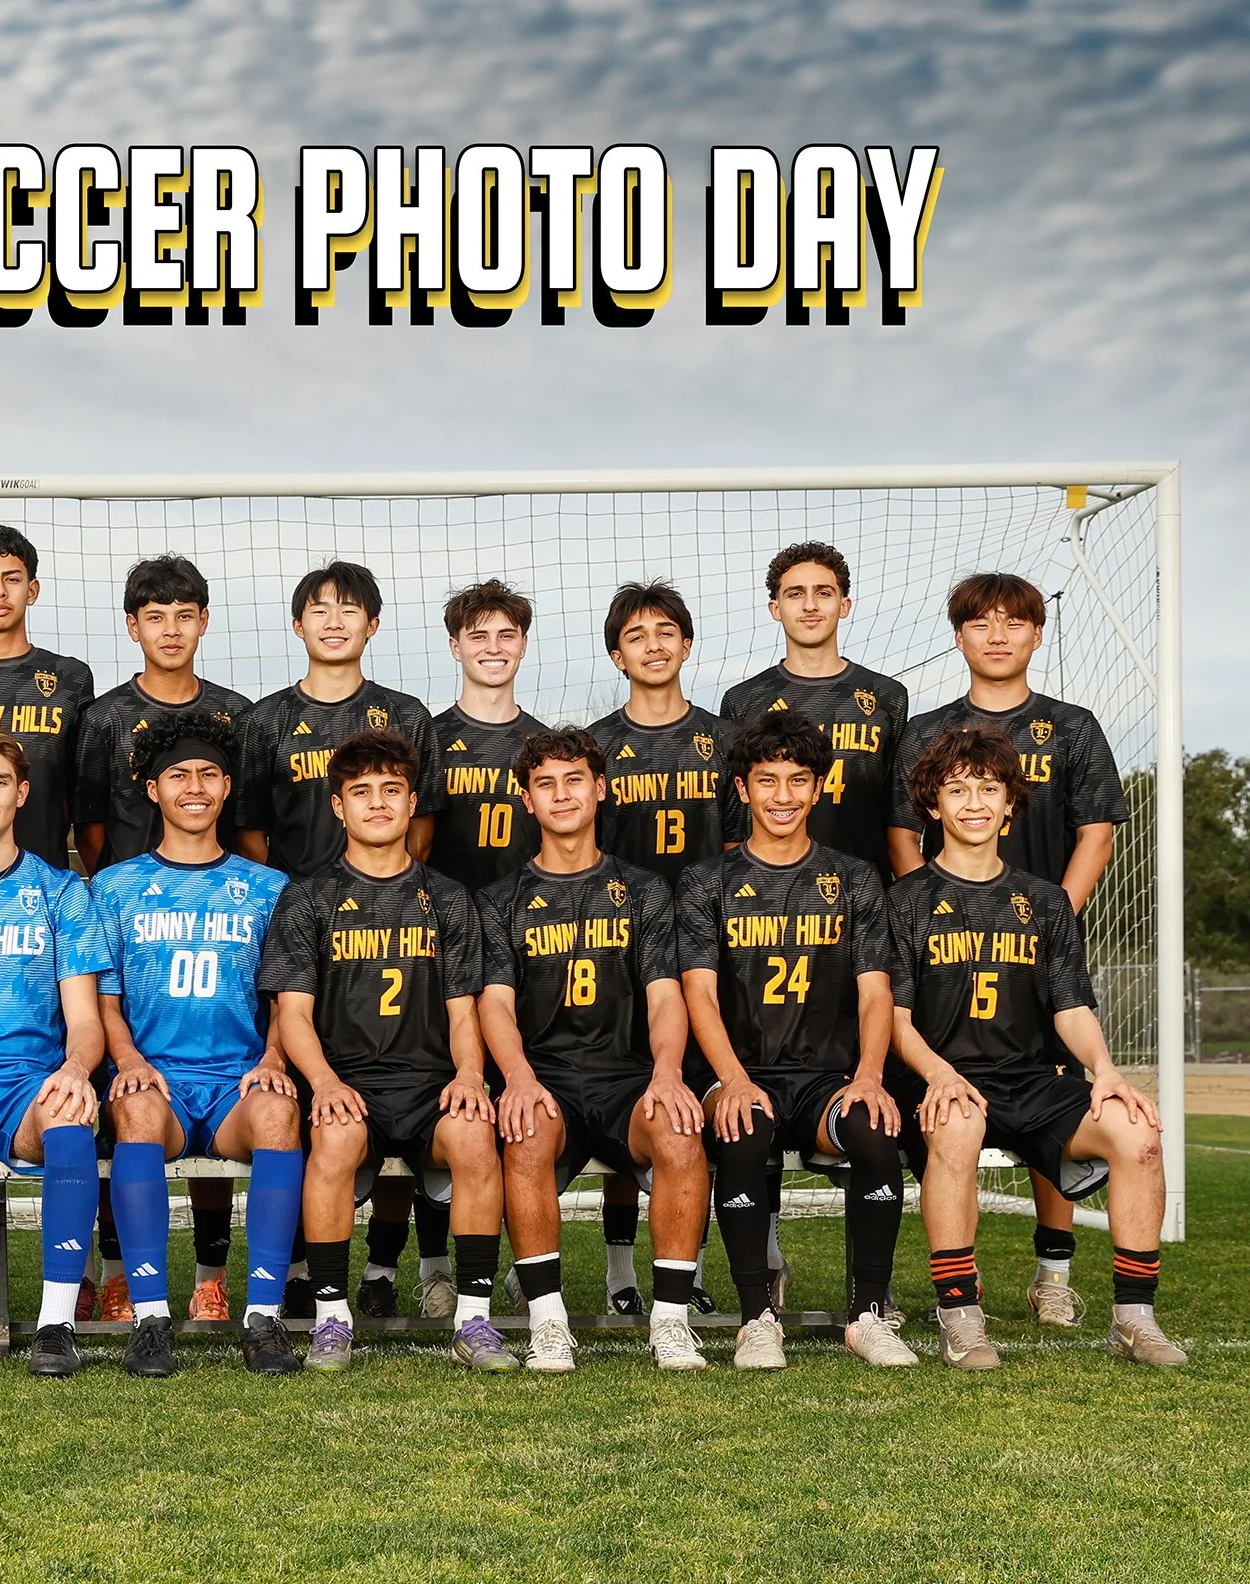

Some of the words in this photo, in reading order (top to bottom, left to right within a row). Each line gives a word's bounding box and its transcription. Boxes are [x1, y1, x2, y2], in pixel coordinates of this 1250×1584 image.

[12, 706, 61, 734] HILLS
[832, 723, 881, 753] HILLS
[290, 749, 336, 783] SUN
[444, 767, 501, 795] UNNY
[823, 759, 846, 804] 4
[1020, 754, 1052, 783] LLS
[611, 774, 668, 805] SUNNY
[478, 803, 513, 847] 10
[655, 810, 685, 854] 13
[134, 912, 195, 944] SUNNY
[203, 913, 253, 944] HILLS
[585, 918, 629, 948] HILLS
[727, 916, 788, 947] SUNNY
[796, 915, 843, 945] HILLS
[332, 929, 391, 960] SUNNY
[992, 933, 1038, 965] HILLS
[169, 950, 217, 998] 00
[565, 959, 596, 1006] 18
[763, 956, 810, 1004] 24
[380, 968, 403, 1015] 2
[970, 972, 998, 1019] 15
